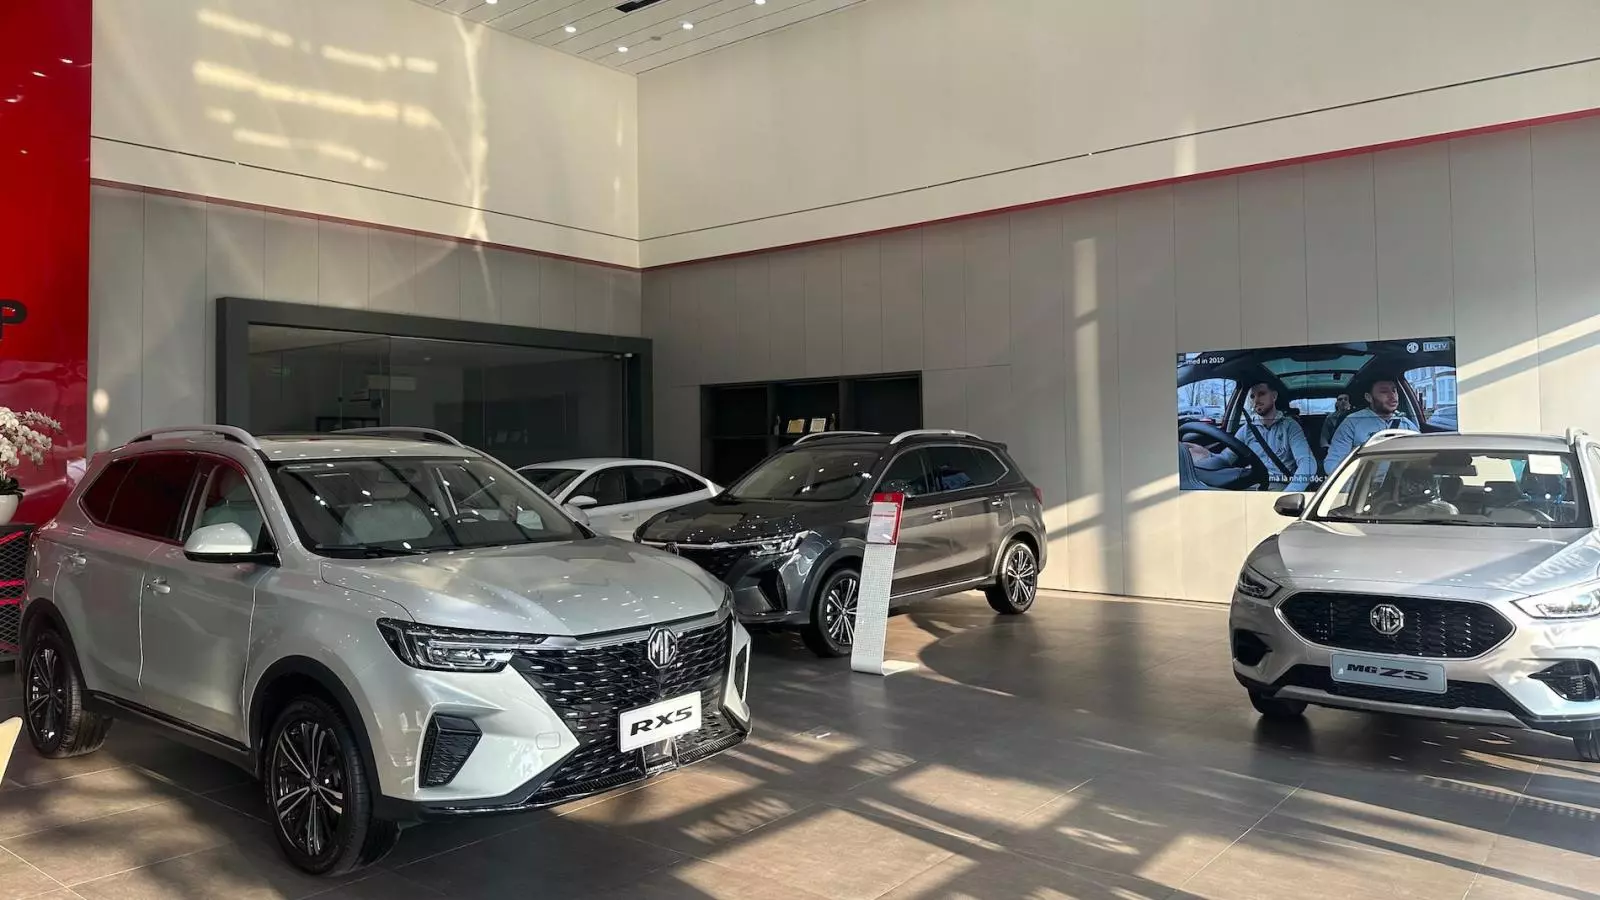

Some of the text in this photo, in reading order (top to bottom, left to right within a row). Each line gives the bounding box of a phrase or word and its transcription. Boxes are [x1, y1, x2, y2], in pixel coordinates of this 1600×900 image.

[1209, 356, 1225, 364] 2019
[1372, 606, 1400, 632] MG
[650, 629, 676, 667] MG
[630, 706, 692, 736] RX5
